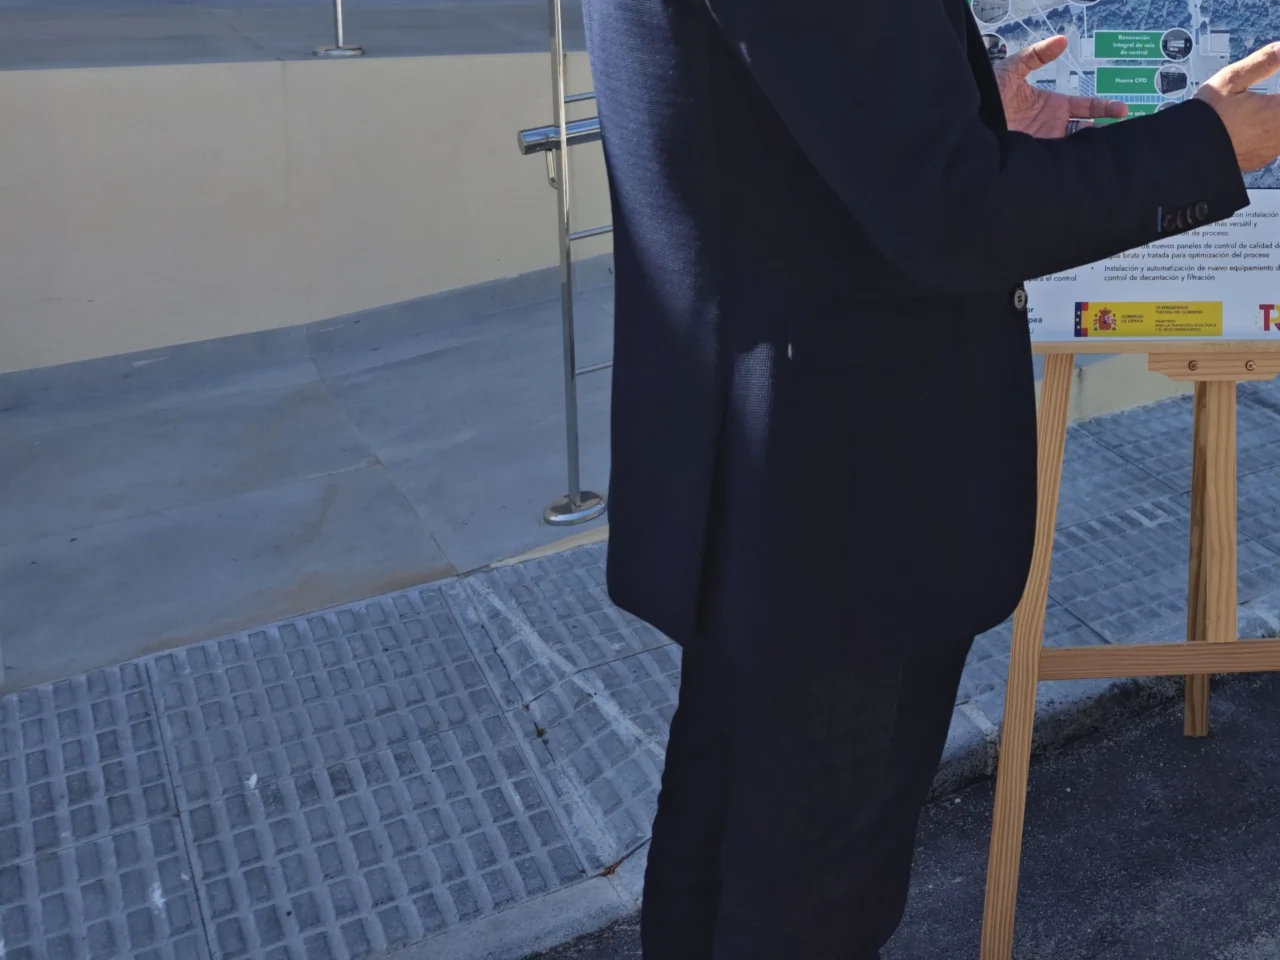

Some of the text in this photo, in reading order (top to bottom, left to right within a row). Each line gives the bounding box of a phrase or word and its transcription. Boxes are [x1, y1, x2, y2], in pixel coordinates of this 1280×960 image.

[1191, 229, 1200, 237] de
[1176, 242, 1202, 250] paneles
[1147, 251, 1170, 259] tratada
[1104, 264, 1139, 272] Instalación
[1146, 264, 1195, 272] automatización
[1054, 274, 1077, 282] control
